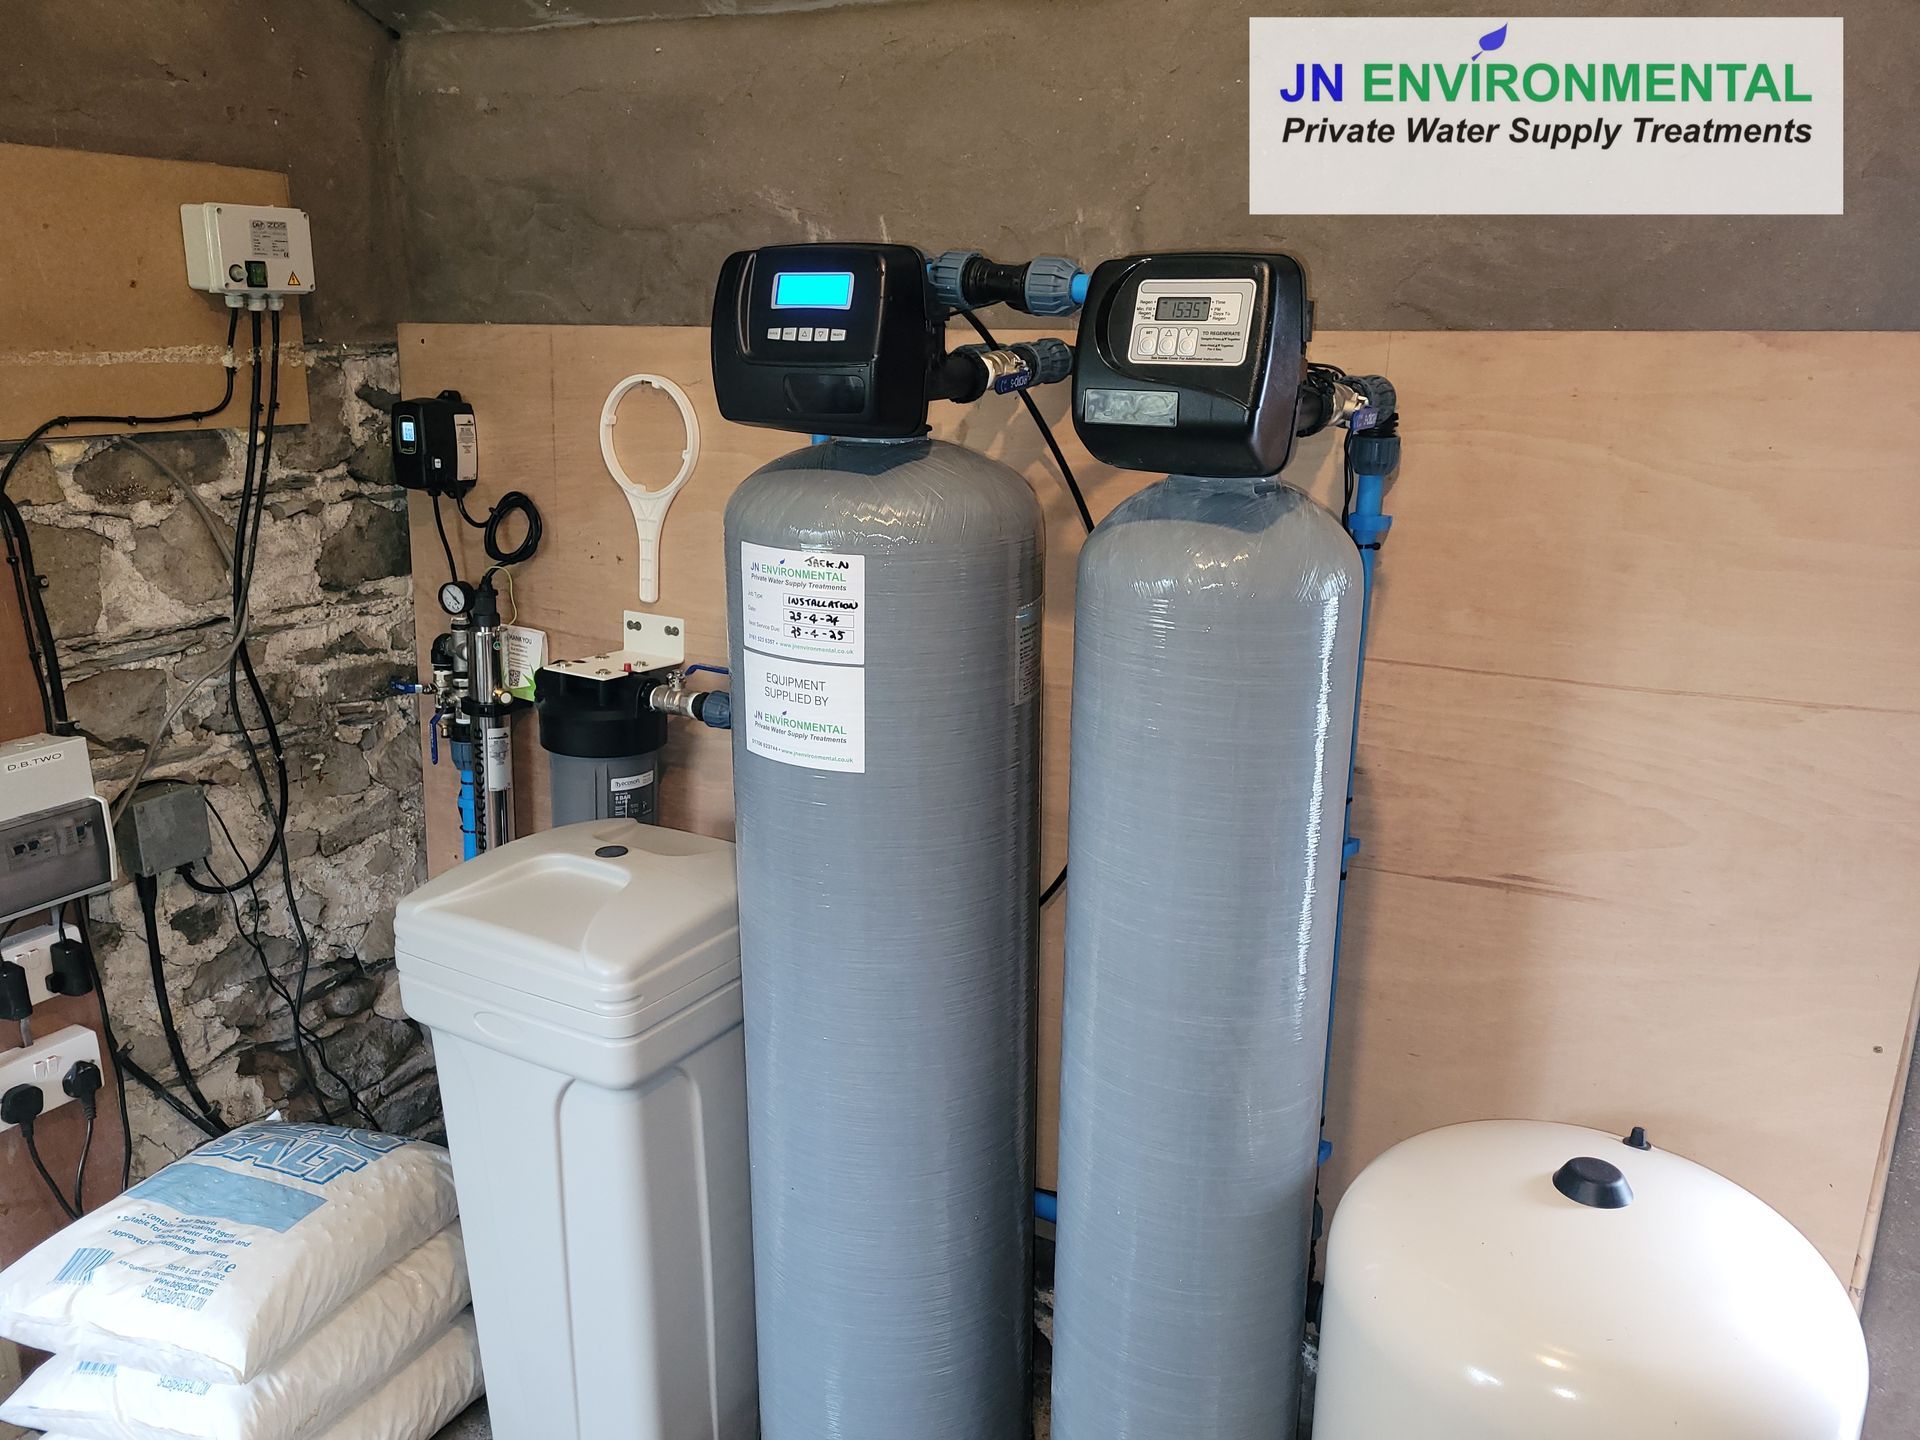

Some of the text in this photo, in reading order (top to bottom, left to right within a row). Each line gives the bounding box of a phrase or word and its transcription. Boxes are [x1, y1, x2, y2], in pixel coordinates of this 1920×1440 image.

[751, 561, 847, 583] JN ENVIRONMENTAL
[751, 572, 847, 591] Private Water Supply Treatments
[787, 596, 858, 610] INSTALLATION
[766, 672, 826, 691] EQUIPMENT
[764, 686, 829, 706] SUPPLIED BY
[754, 710, 847, 735] JN ENVIRONMENTAL
[755, 721, 847, 743] Private Water Supply Treatments
[7, 753, 62, 771] D.B.TWO
[474, 728, 487, 853] BLACKCOMB
[192, 1133, 368, 1185] SALT
[111, 1229, 148, 1245] Approved
[150, 1223, 162, 1233] for
[183, 1229, 203, 1238] water
[235, 1240, 253, 1248] and
